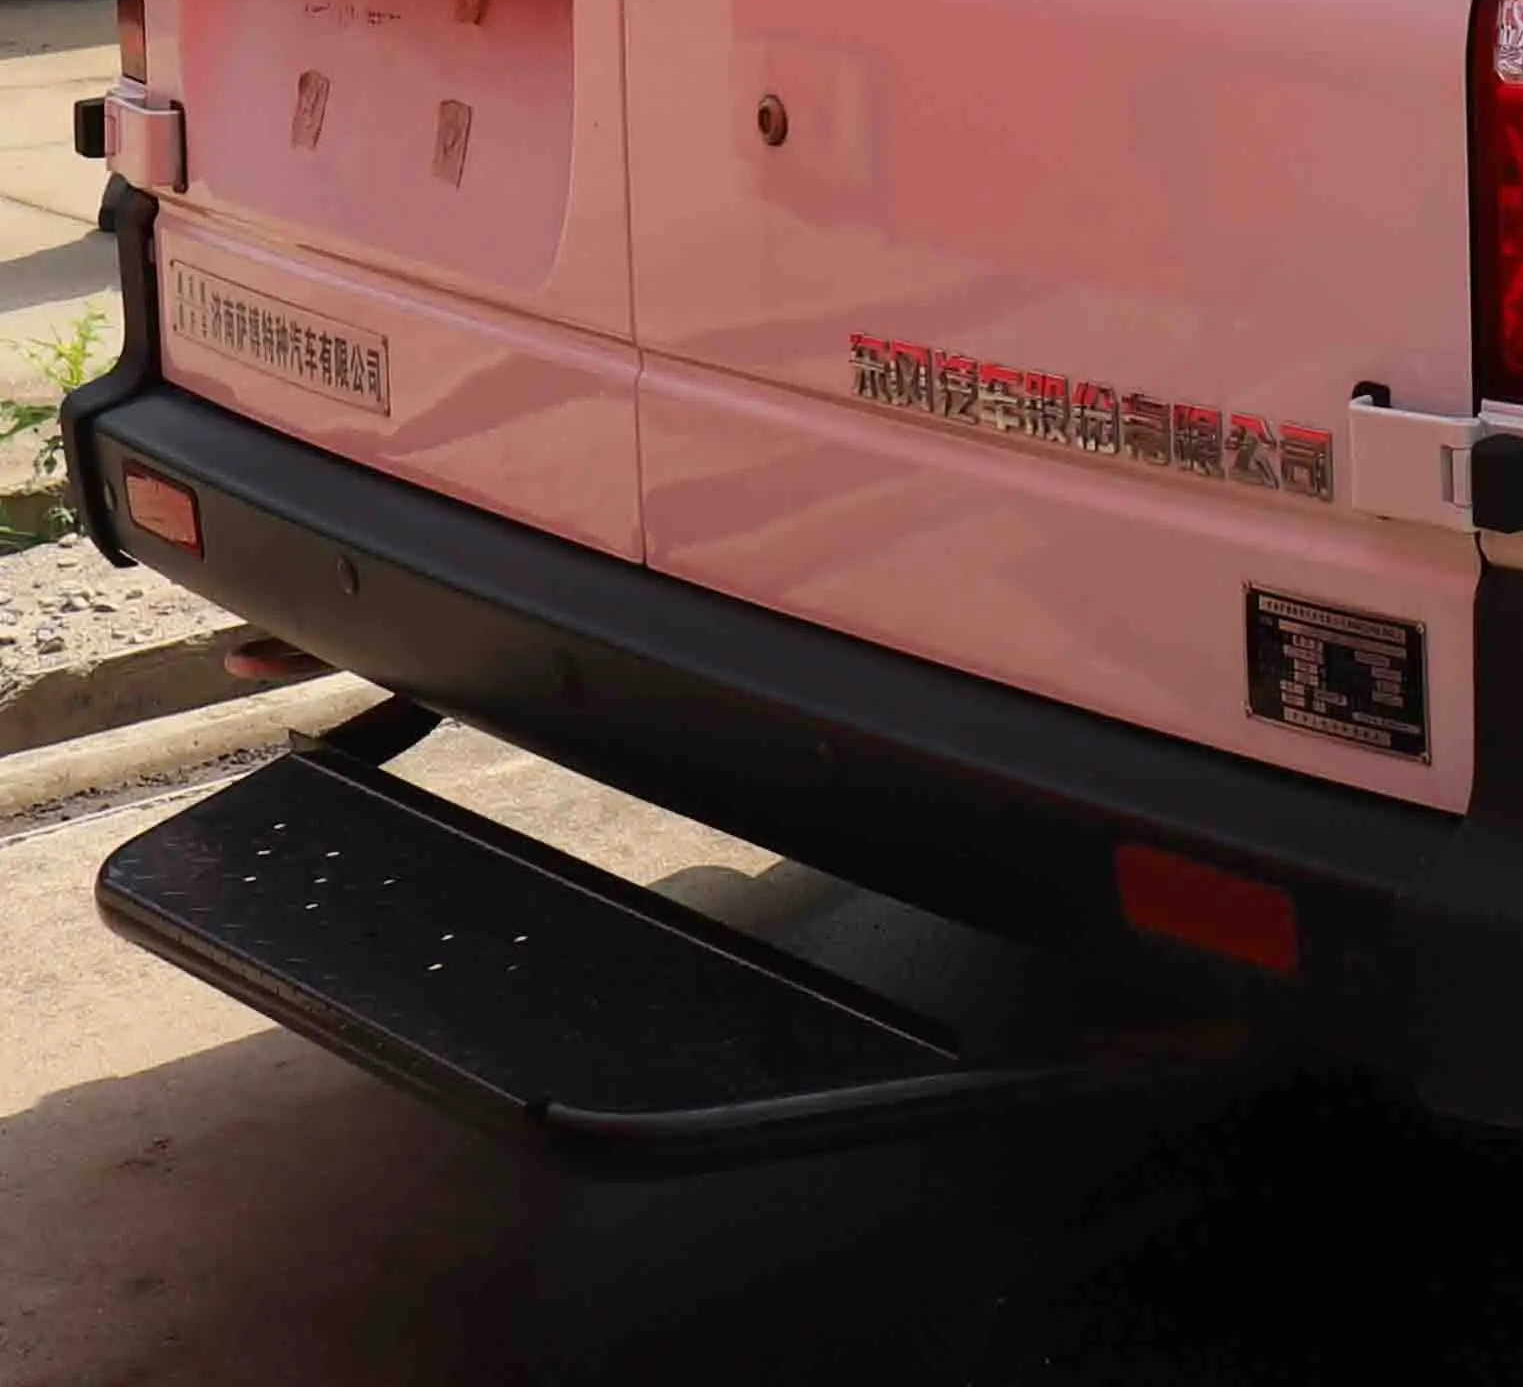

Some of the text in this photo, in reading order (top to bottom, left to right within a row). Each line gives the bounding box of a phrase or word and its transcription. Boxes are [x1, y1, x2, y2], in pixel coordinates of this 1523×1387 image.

[849, 332, 1335, 502] 东风汽车股份有限公司
